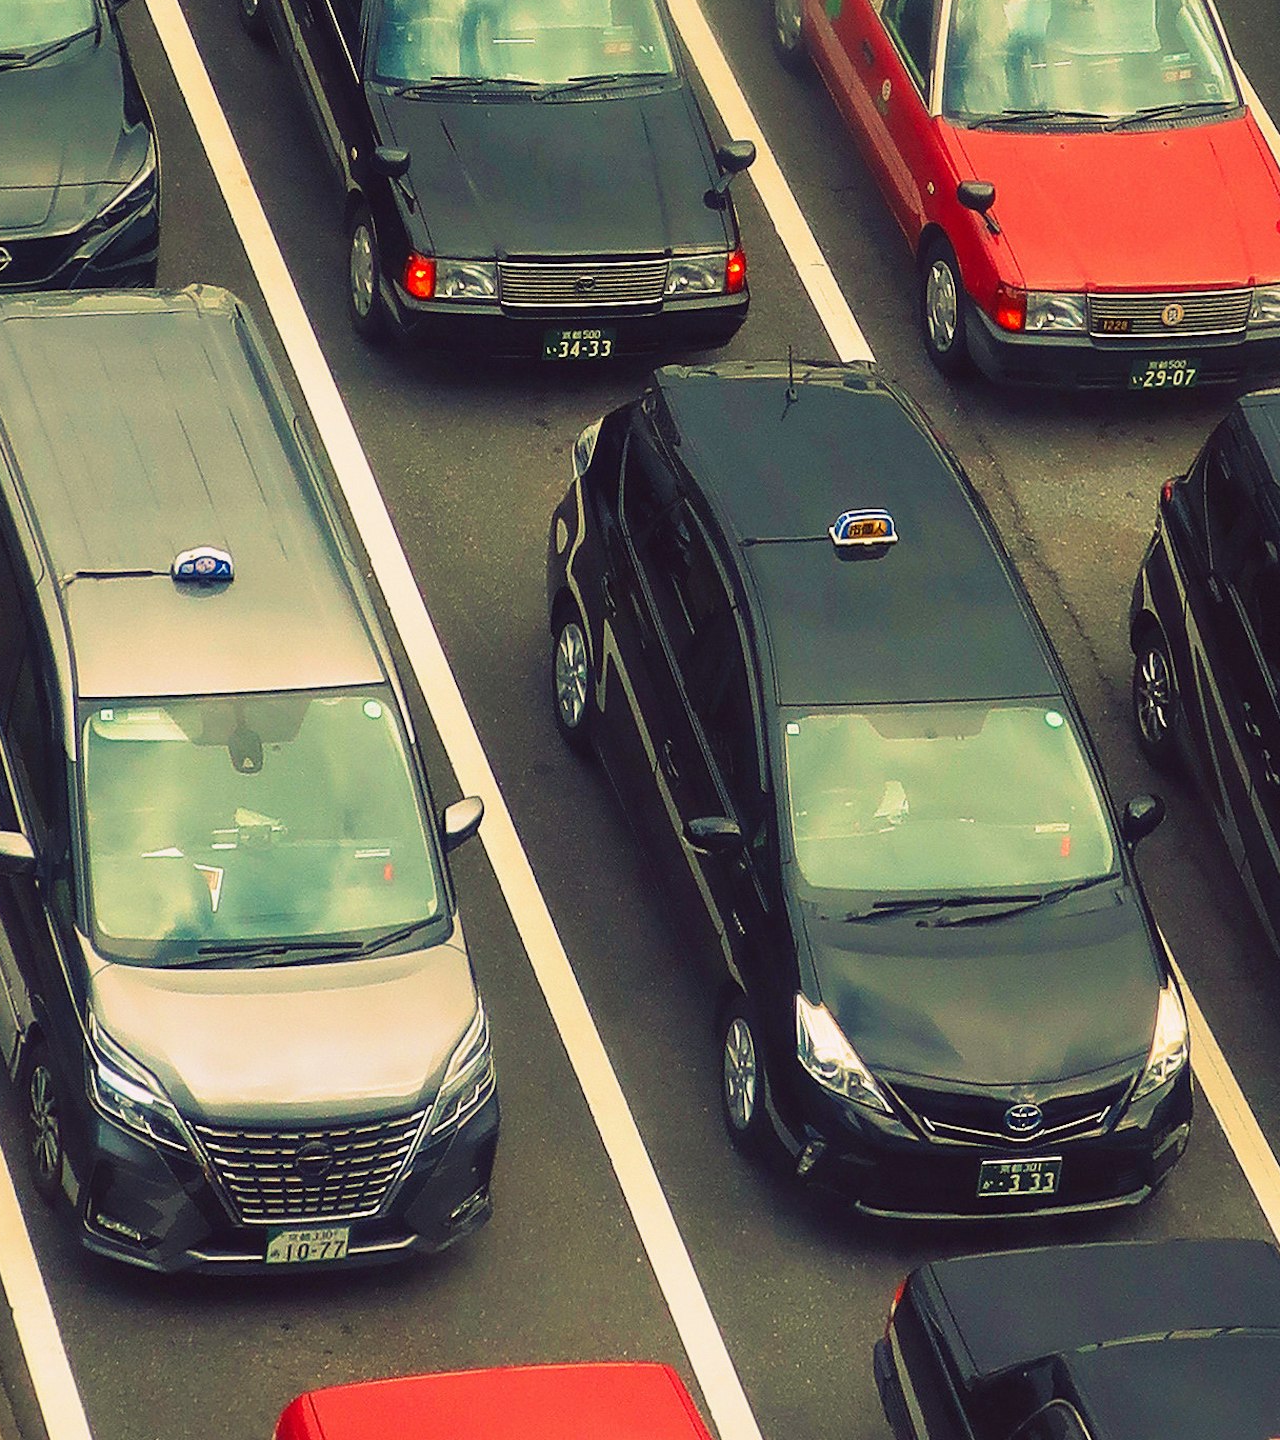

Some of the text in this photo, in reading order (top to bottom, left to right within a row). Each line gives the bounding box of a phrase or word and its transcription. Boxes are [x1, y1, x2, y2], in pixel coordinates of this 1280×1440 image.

[558, 340, 612, 358] 34-33
[1143, 369, 1196, 387] 29-07
[286, 1240, 346, 1262] 10-77
